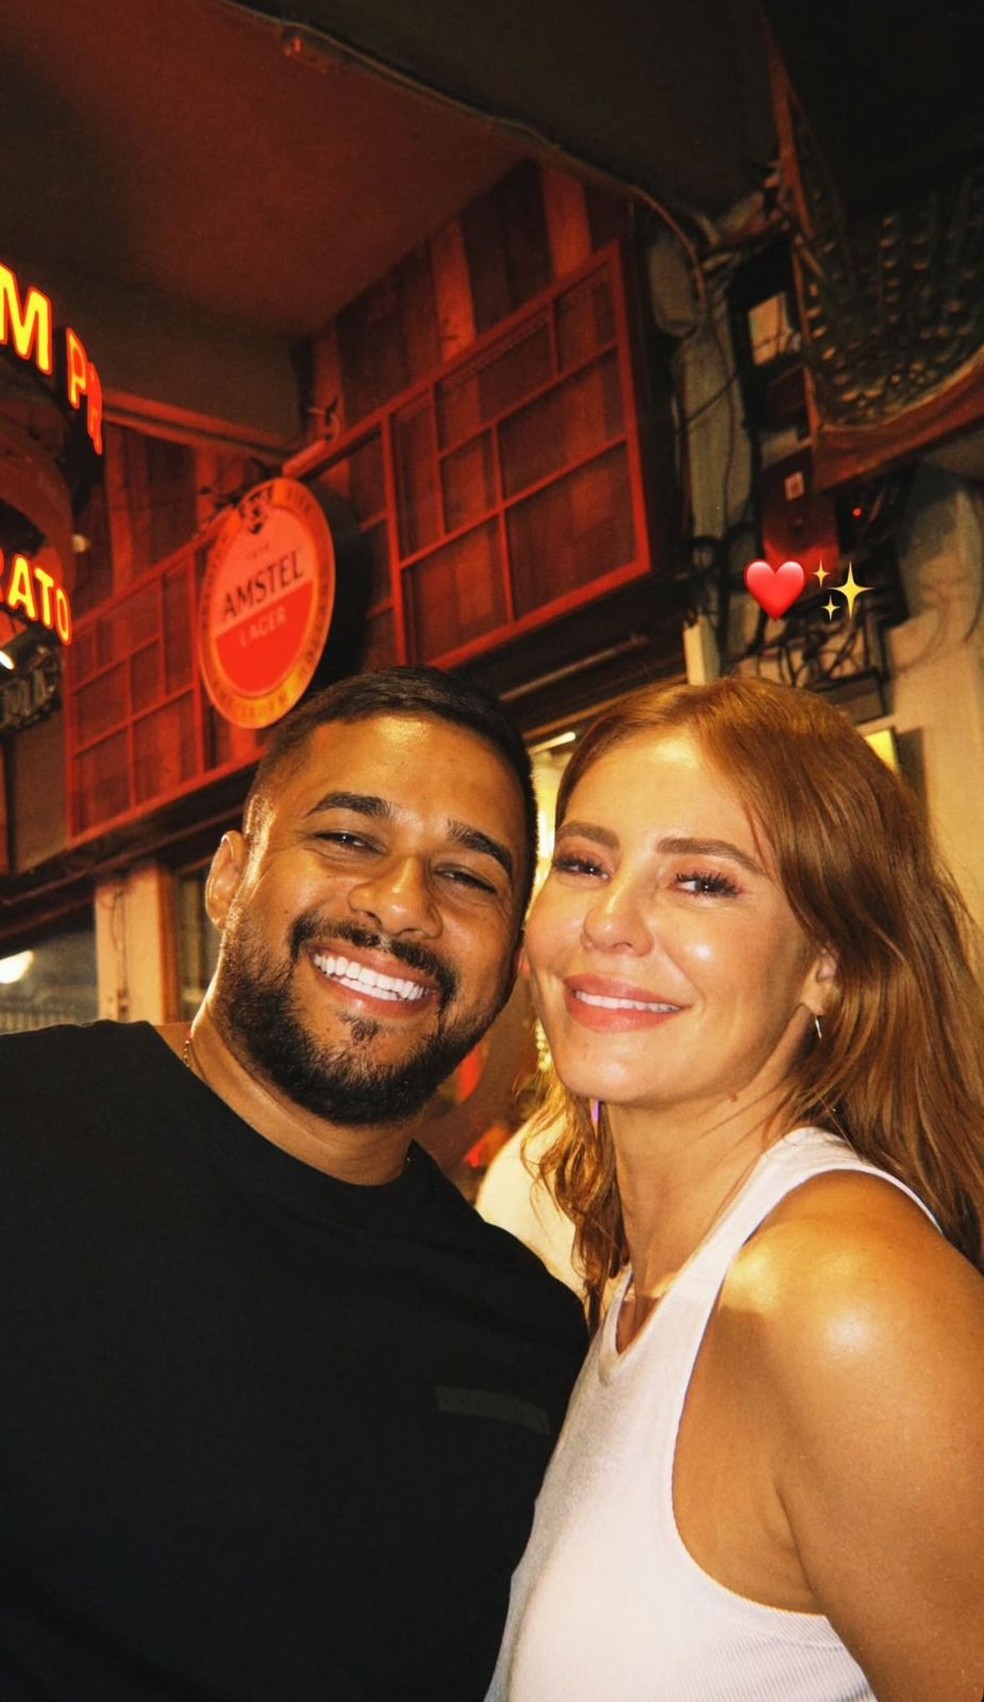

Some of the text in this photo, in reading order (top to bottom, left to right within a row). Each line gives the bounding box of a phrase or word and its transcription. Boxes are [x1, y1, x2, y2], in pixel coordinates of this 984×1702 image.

[0, 549, 73, 647] ATO
[224, 549, 304, 617] AMSTEL
[239, 605, 287, 648] LAGER
